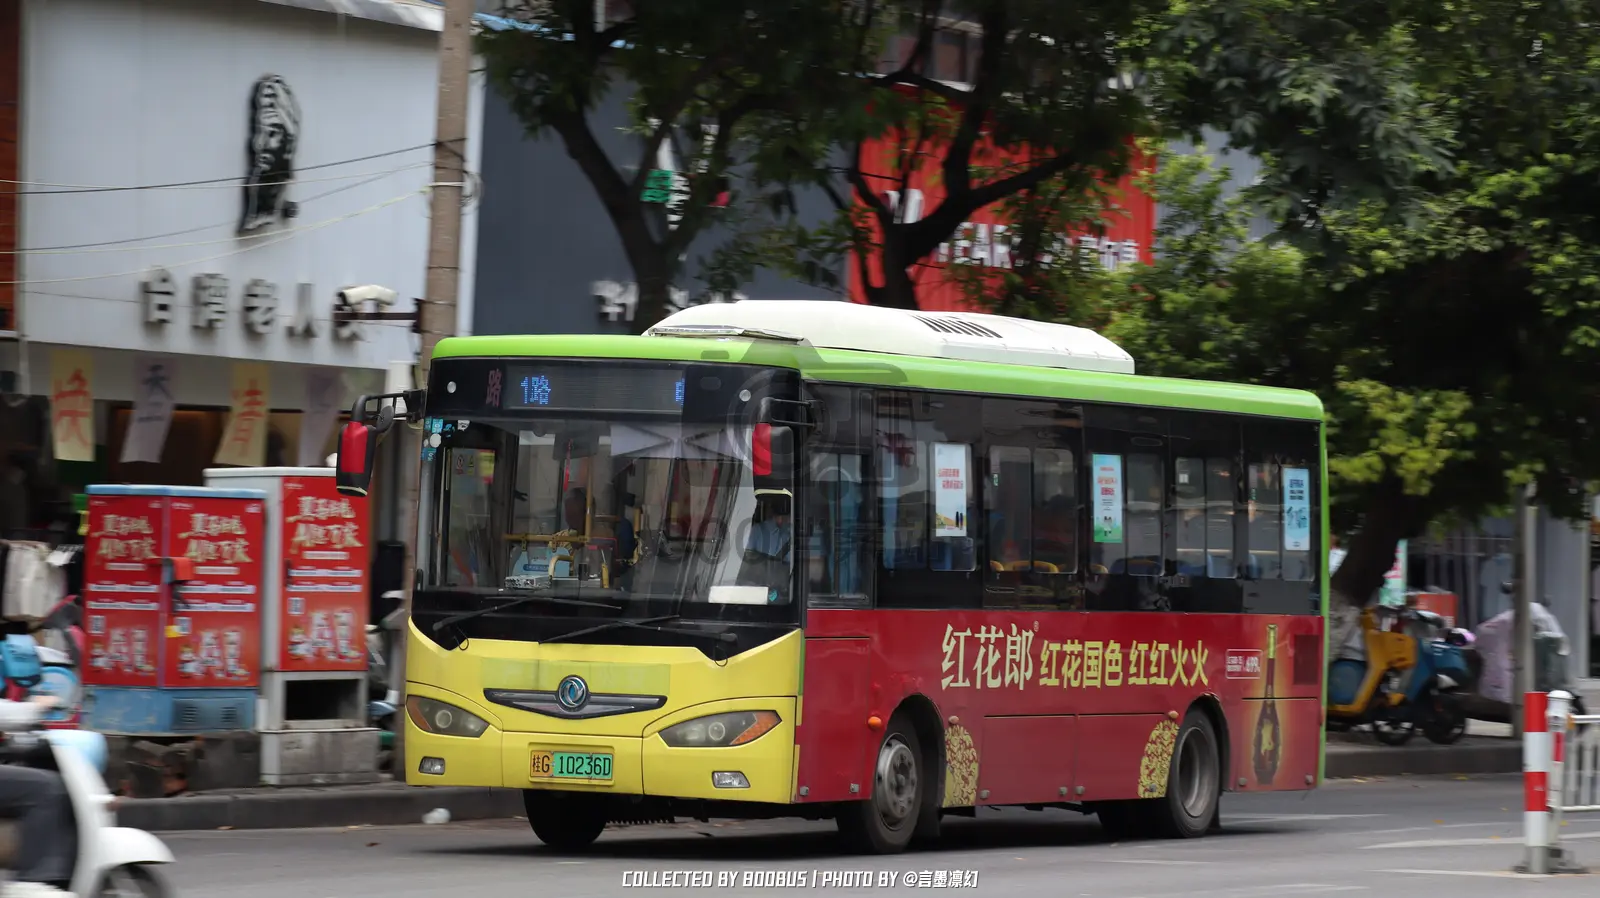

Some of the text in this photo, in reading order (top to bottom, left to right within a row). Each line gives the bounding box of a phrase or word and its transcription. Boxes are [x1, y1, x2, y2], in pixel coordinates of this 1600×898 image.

[486, 368, 502, 408] 路
[521, 375, 551, 405] 1路
[941, 624, 1035, 690] 红花郎
[1039, 639, 1209, 689] 红花国色 红红火火
